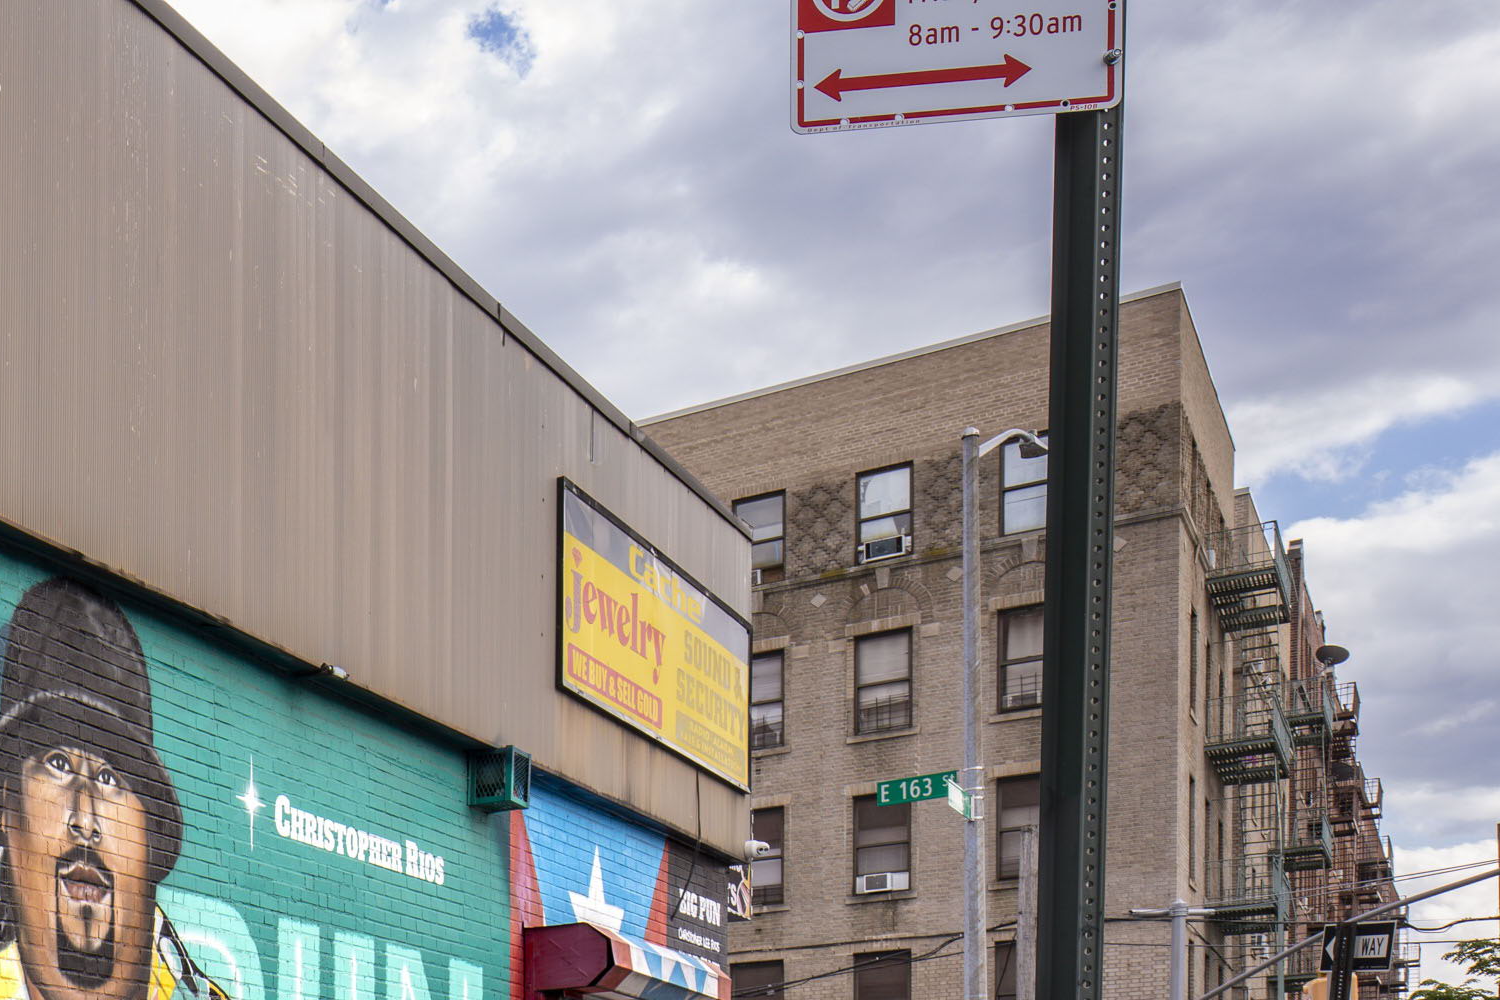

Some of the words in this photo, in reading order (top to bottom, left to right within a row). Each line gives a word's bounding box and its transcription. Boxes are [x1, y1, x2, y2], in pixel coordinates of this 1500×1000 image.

[908, 23, 960, 47] 8am
[990, 12, 1082, 39] 9:30am
[565, 547, 666, 686] jewelry
[572, 652, 589, 678] WE
[589, 661, 609, 691] BUY
[616, 678, 637, 709] SELL
[637, 693, 659, 723] GOLD
[684, 629, 731, 690] SOUND
[676, 667, 745, 741] SECURITY
[880, 784, 890, 803] E
[899, 777, 932, 800] 163
[941, 773, 955, 787] St
[274, 794, 404, 874] CHRISTOPHER
[405, 839, 445, 886] RIOS
[678, 888, 698, 918] BIG
[698, 896, 722, 927] PUN
[1361, 937, 1385, 956] WAY
